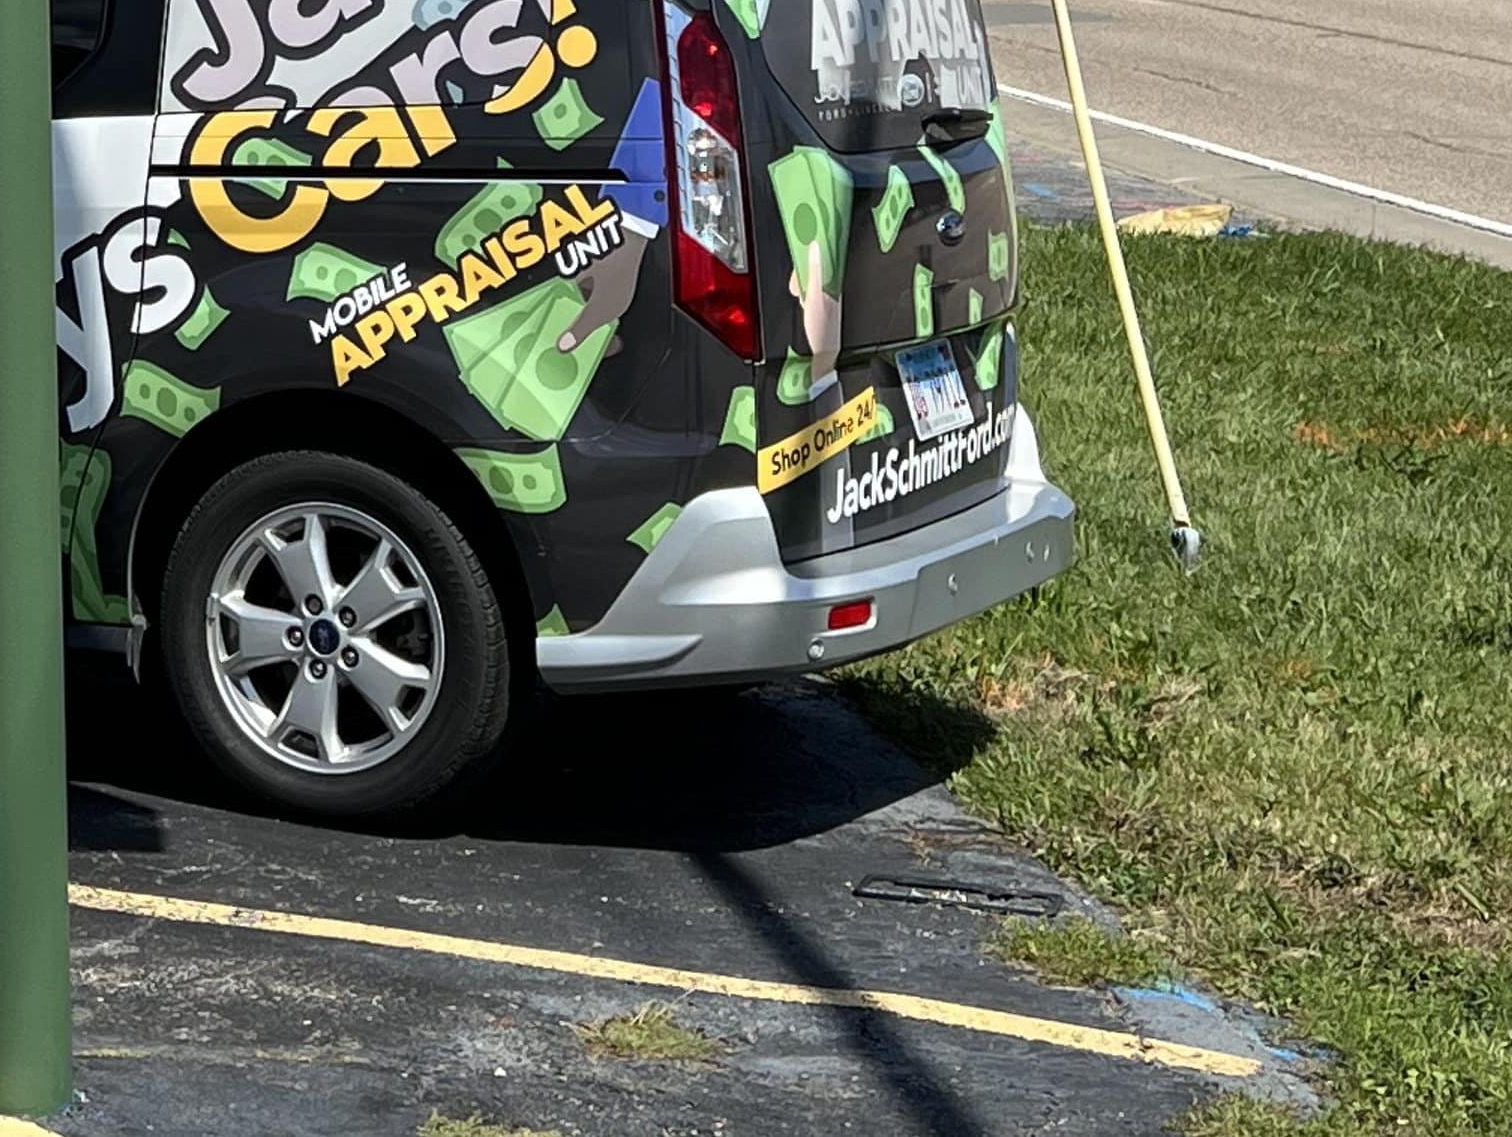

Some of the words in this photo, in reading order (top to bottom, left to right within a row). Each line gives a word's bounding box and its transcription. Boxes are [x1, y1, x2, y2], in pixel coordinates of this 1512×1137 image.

[554, 215, 624, 279] UNIT
[308, 263, 415, 345] MOBILE
[330, 183, 616, 388] APPRAISAL
[772, 442, 811, 476] Shop
[813, 417, 854, 453] Online
